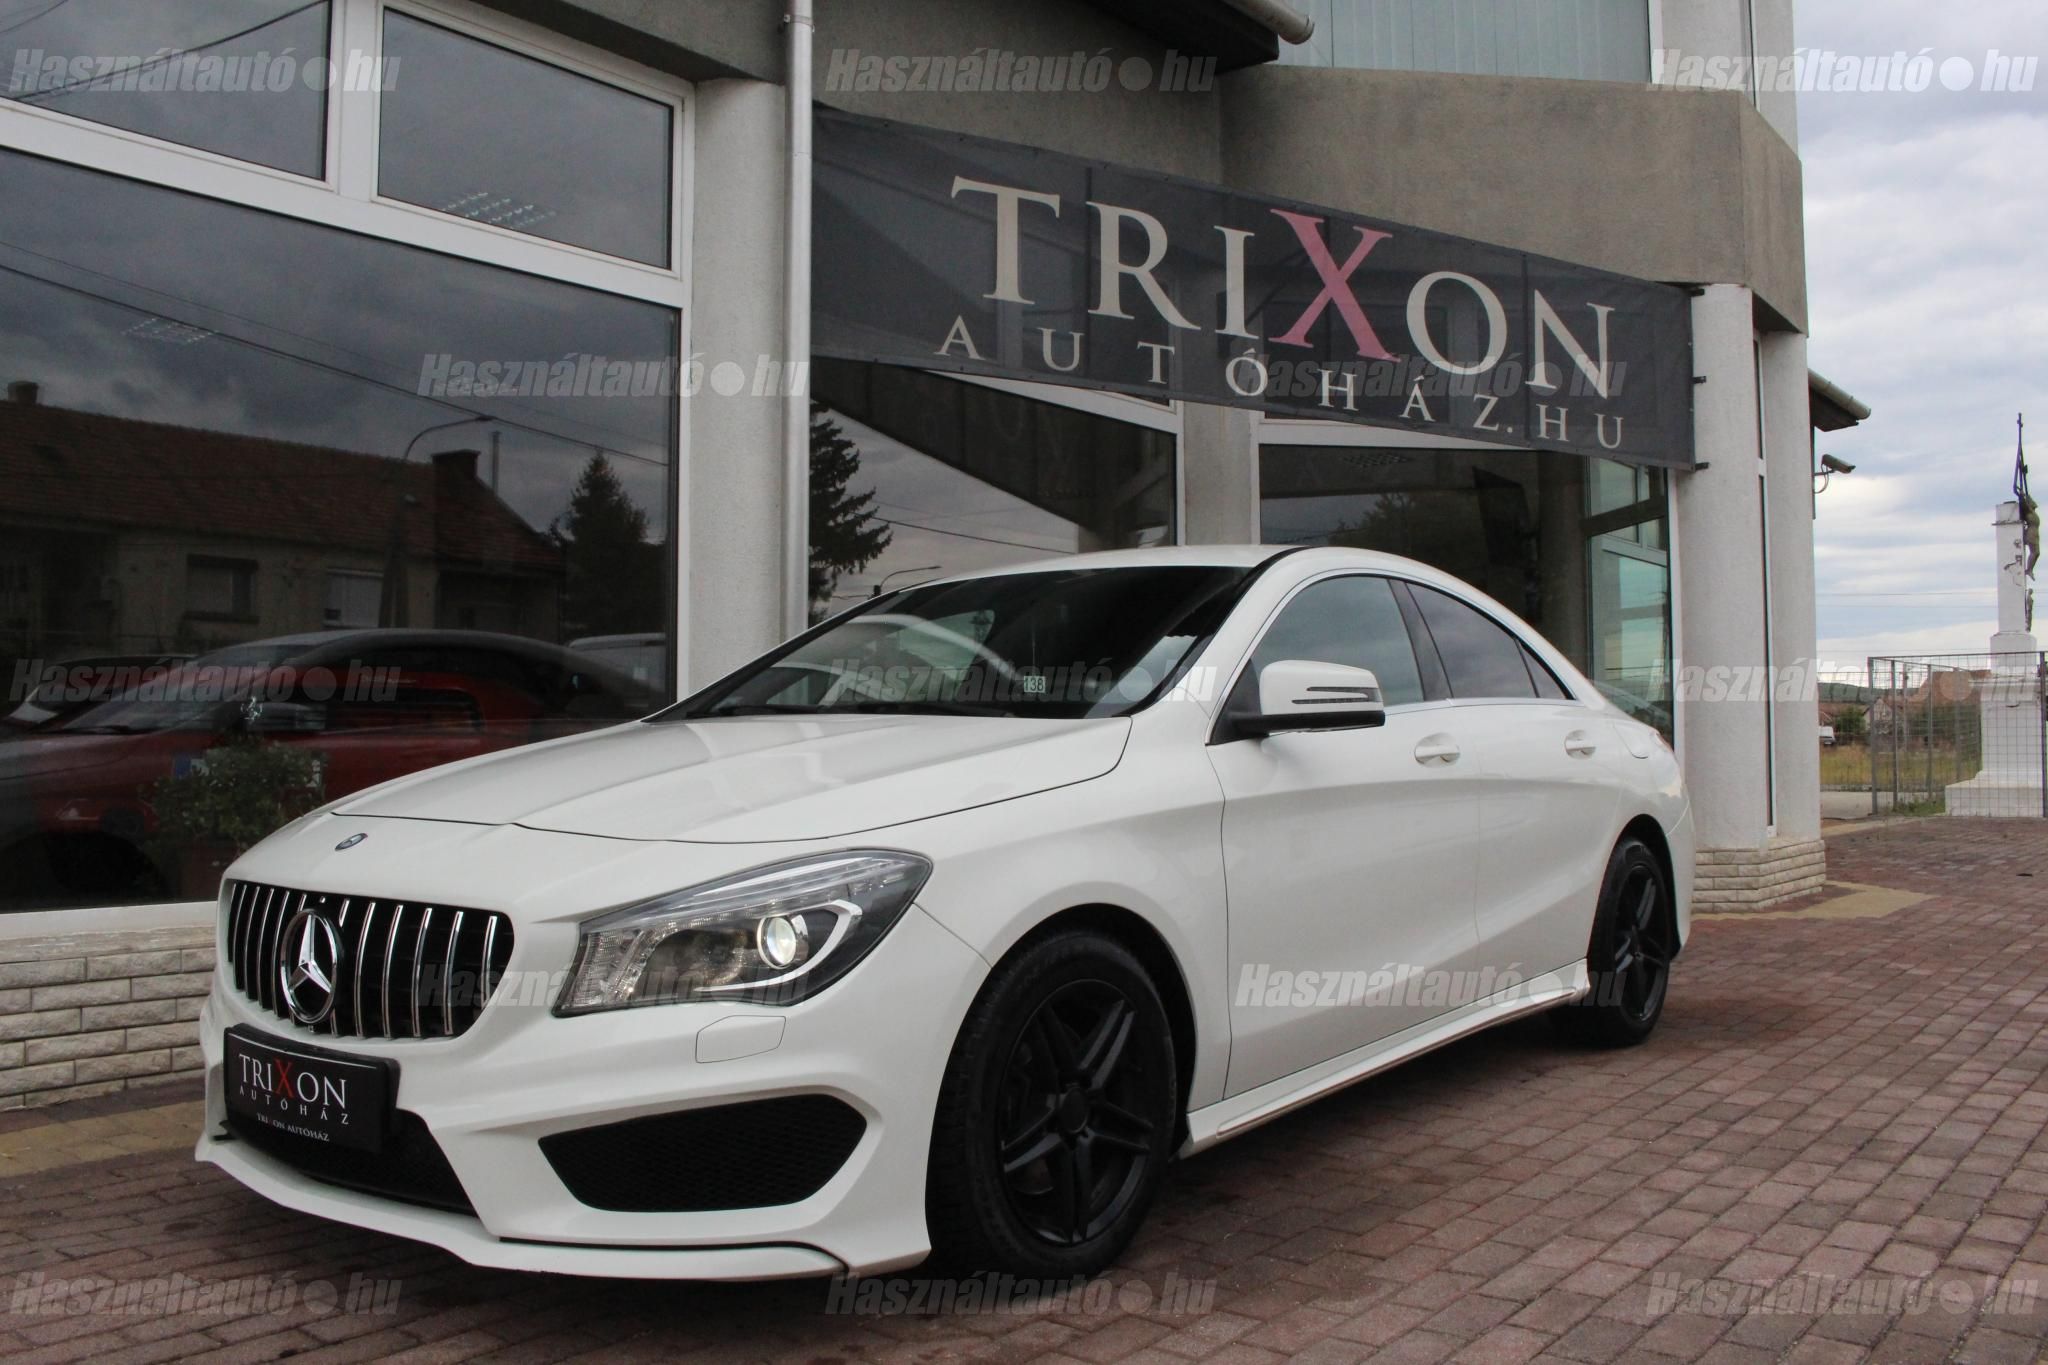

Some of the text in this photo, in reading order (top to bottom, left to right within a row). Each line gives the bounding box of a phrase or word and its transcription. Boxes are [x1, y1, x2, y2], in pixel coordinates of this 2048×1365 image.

[951, 175, 1615, 400] TRIXON
[1024, 677, 1044, 692] 138
[239, 1053, 346, 1109] TRIXON
